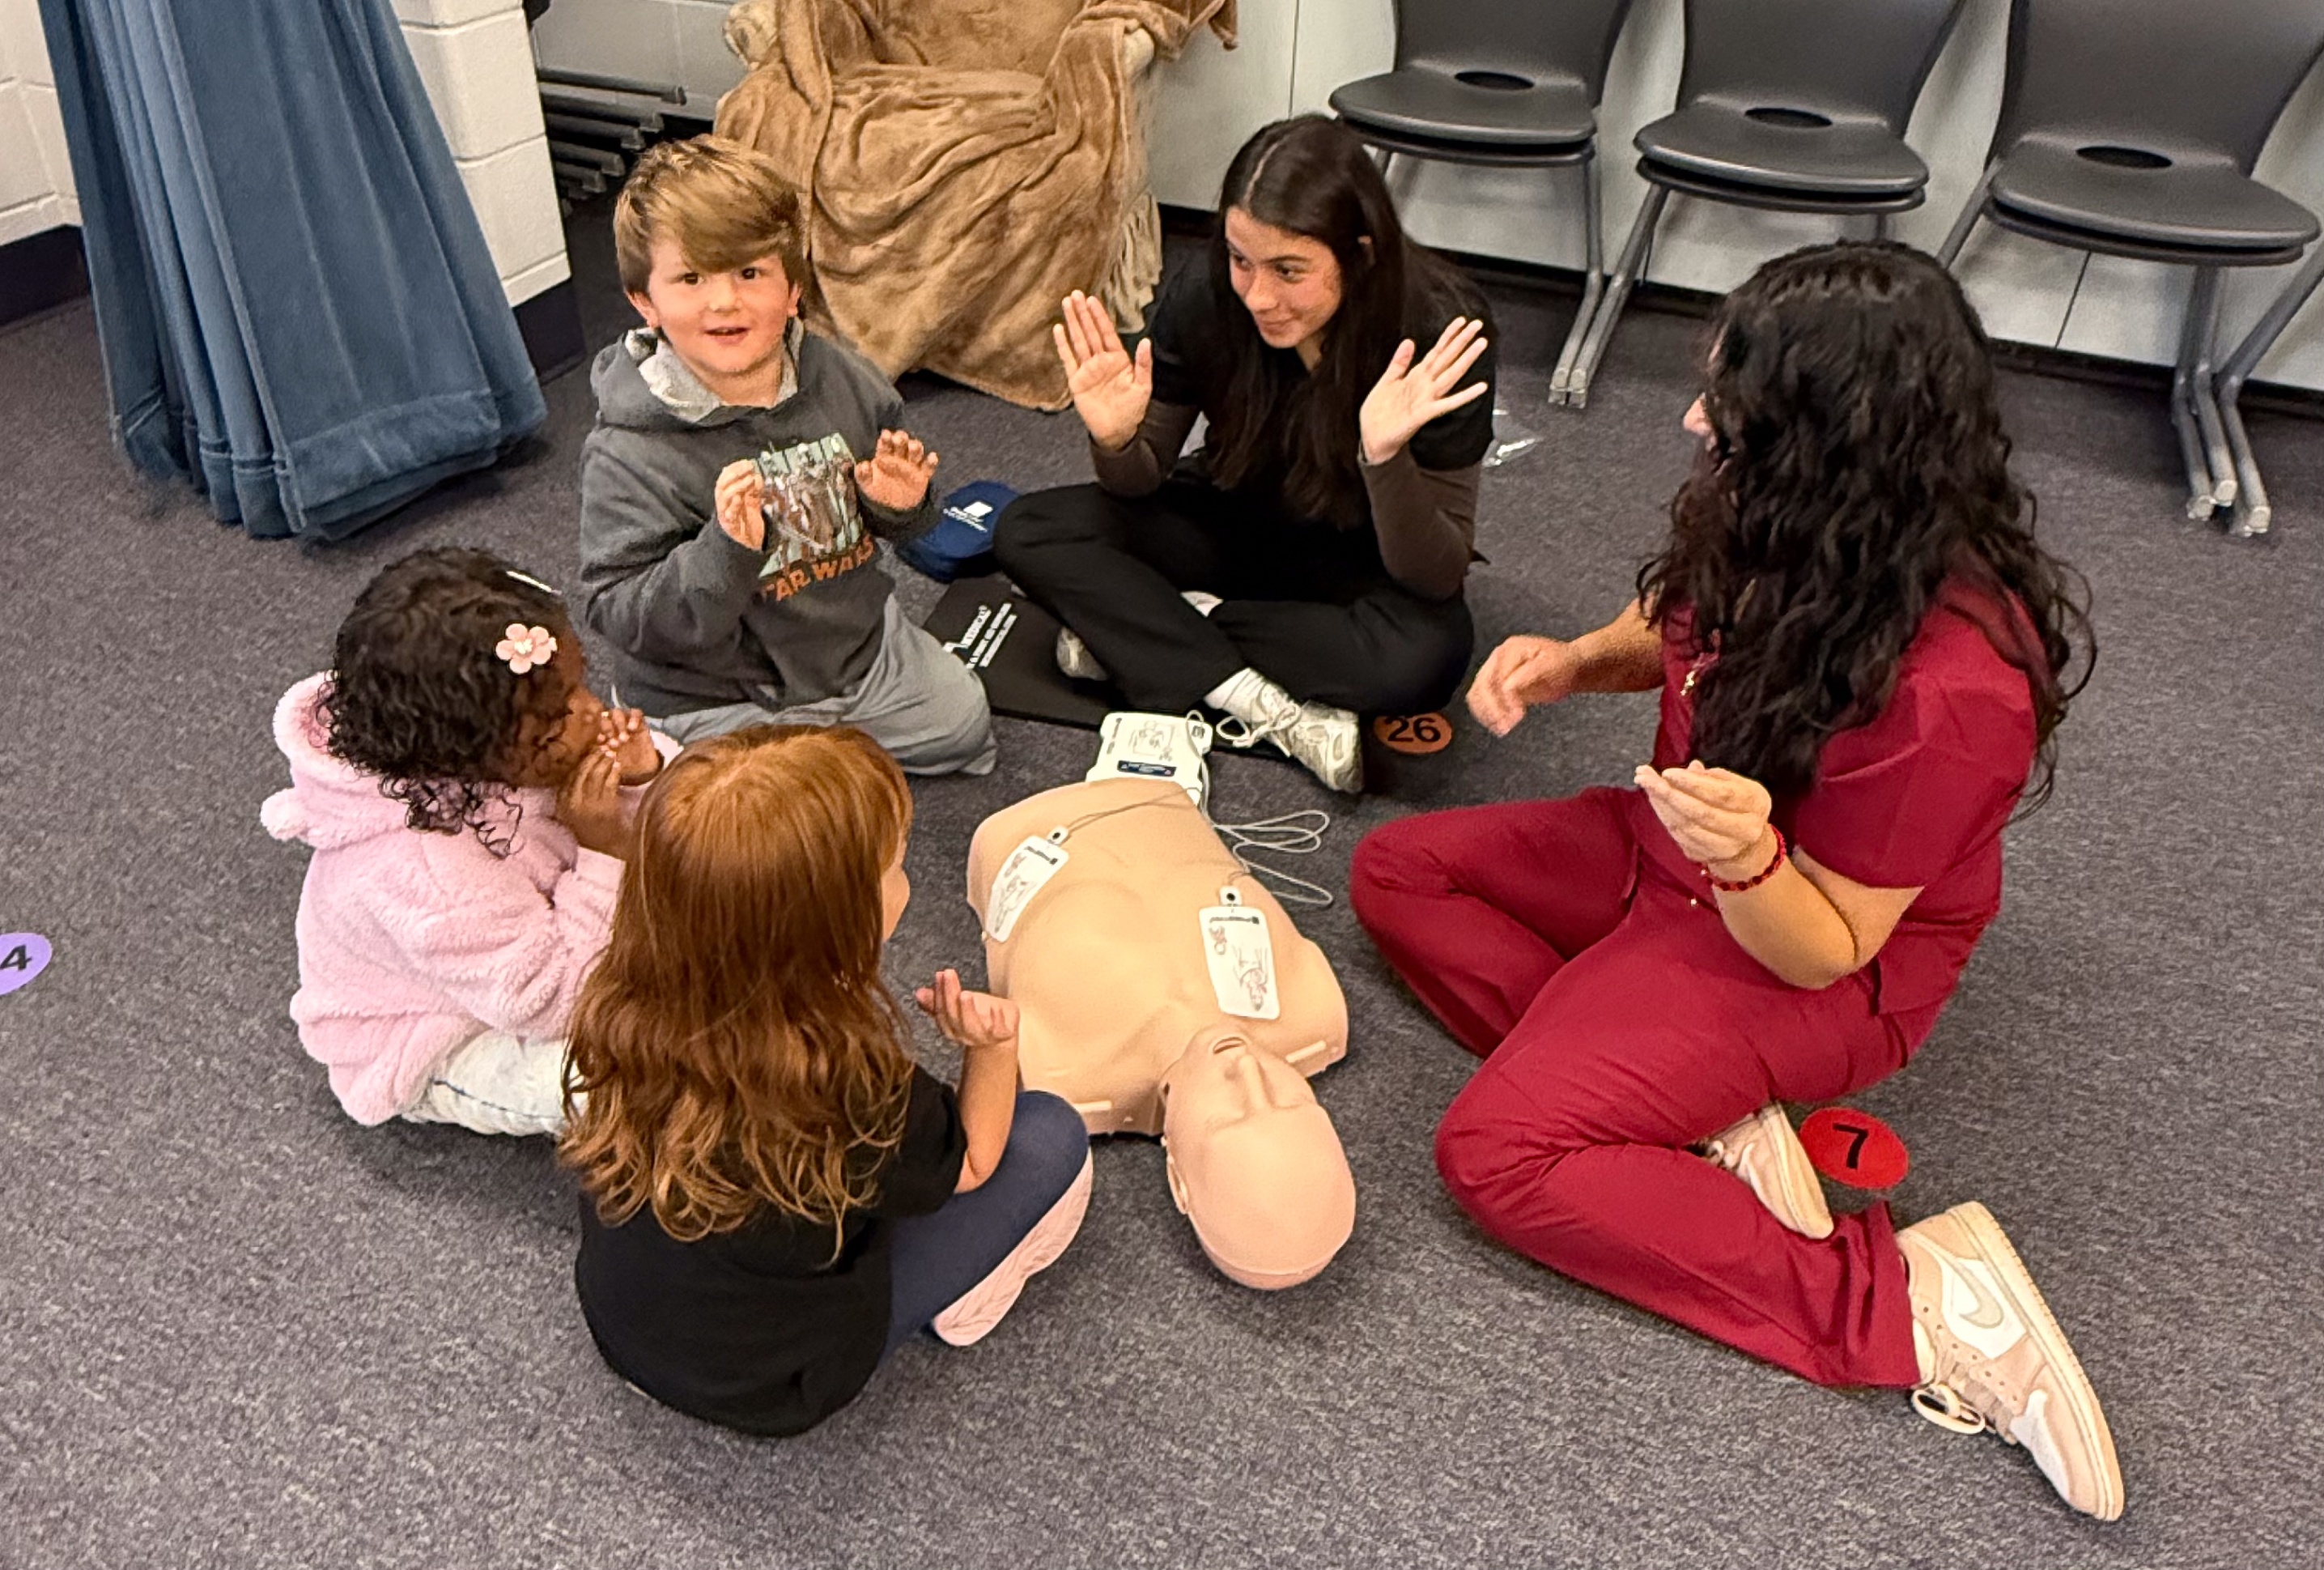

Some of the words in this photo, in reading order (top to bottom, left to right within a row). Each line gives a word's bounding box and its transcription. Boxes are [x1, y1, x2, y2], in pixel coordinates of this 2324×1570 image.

[763, 568, 811, 602] TAR
[1383, 717, 1441, 742] 26
[0, 944, 32, 971] 4
[1831, 1122, 1869, 1169] 7
